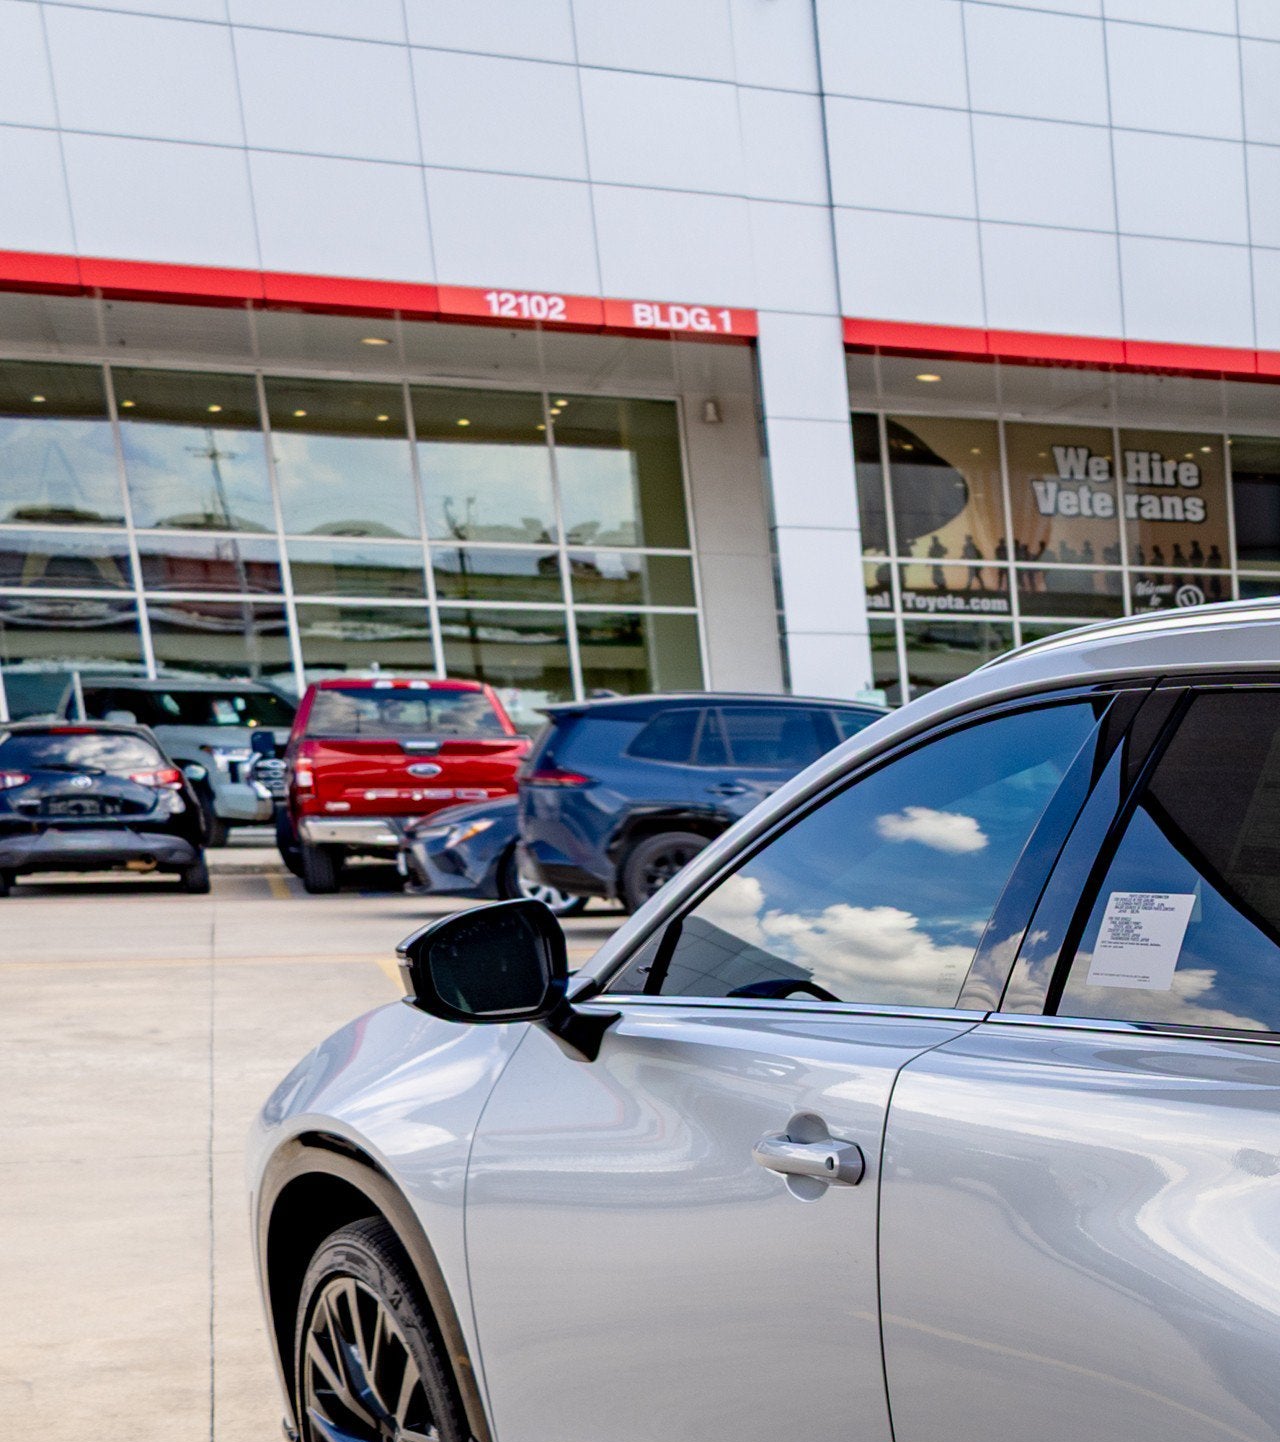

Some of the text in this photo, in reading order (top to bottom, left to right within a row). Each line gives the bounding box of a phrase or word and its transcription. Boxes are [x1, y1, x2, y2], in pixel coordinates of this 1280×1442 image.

[485, 291, 567, 321] 12102
[1052, 446, 1200, 487] We Hire
